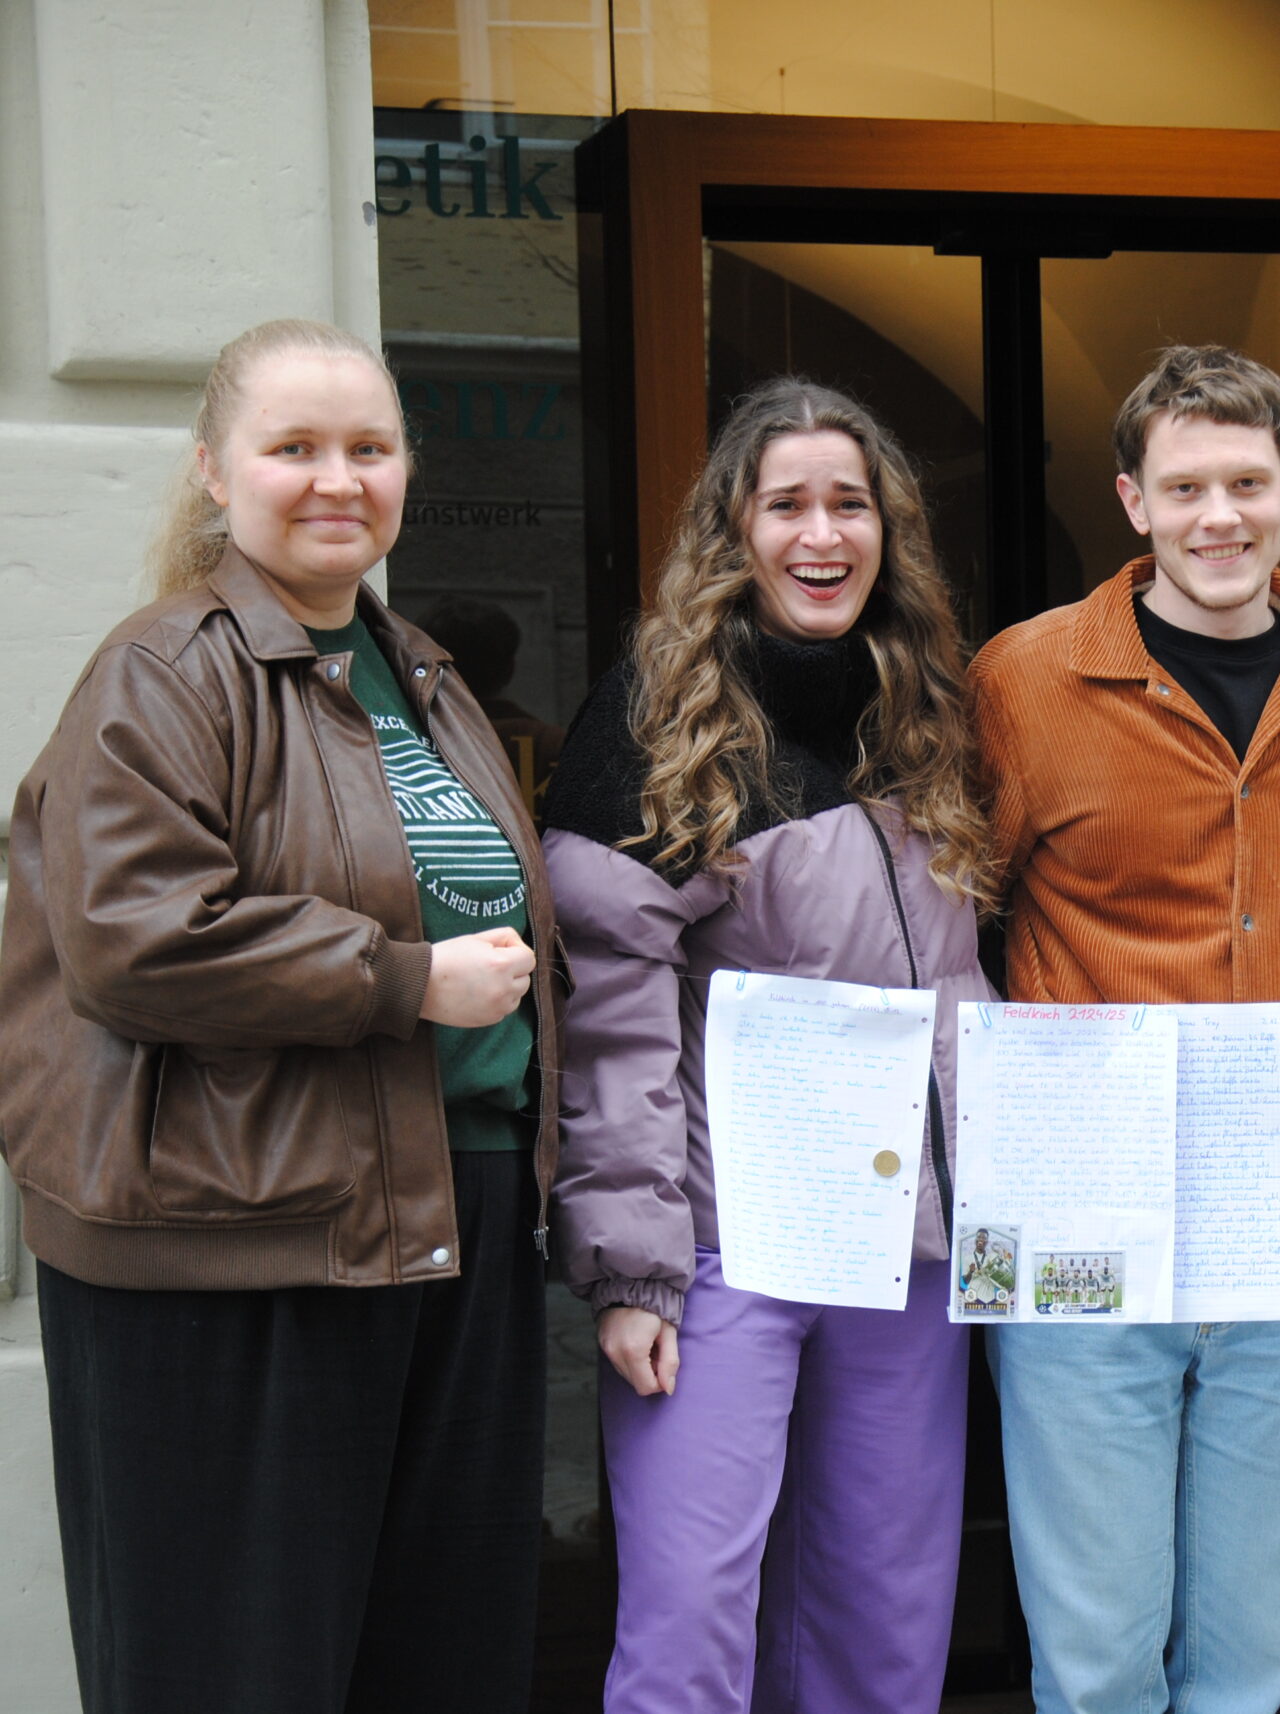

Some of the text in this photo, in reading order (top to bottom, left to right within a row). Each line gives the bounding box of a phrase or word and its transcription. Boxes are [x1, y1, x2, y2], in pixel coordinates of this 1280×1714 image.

[426, 878, 480, 917] EIGHTY
[1003, 1006, 1127, 1022] Feldkirch 2124/25
